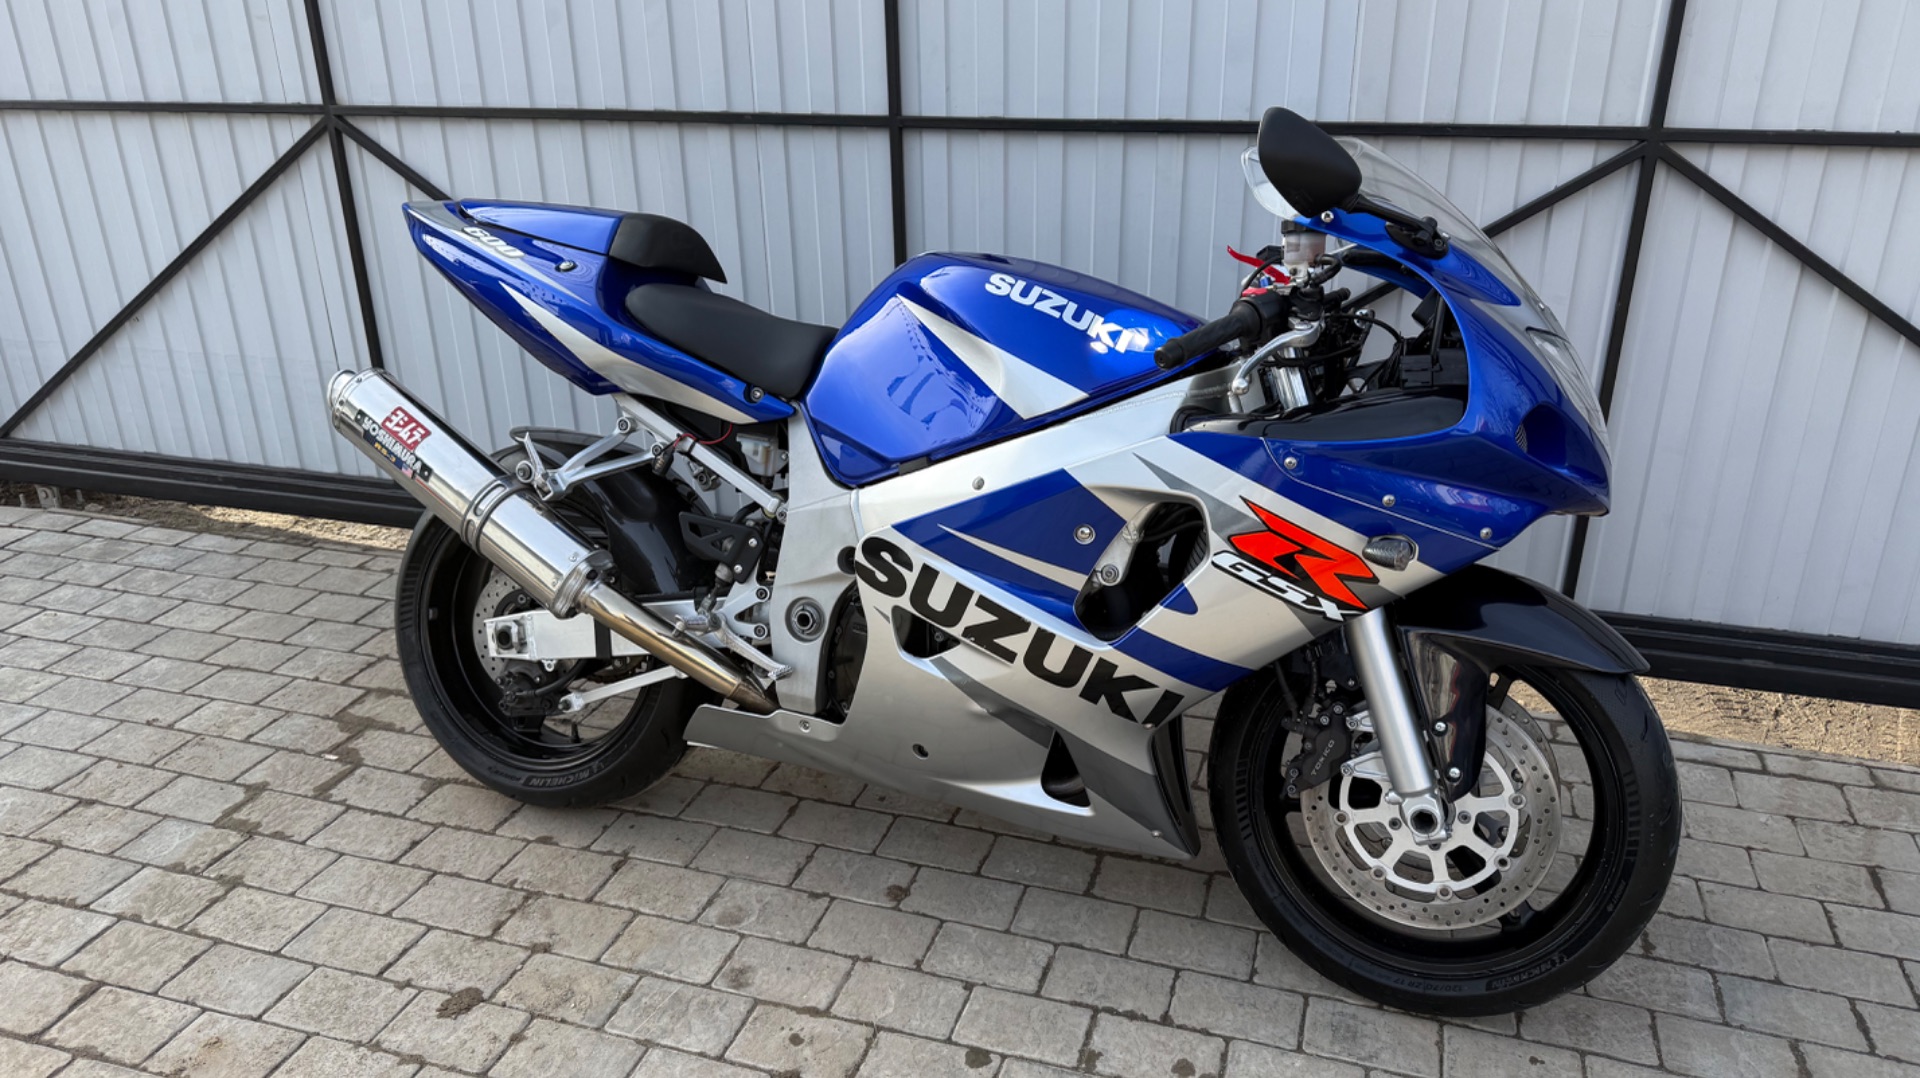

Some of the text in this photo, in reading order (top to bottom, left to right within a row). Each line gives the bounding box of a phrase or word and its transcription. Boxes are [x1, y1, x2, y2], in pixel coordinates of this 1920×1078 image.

[462, 226, 524, 259] 600
[985, 273, 1134, 354] SUZUKI
[362, 416, 422, 474] YOSHIMURA
[384, 410, 426, 444] ヨシムラ
[855, 536, 1185, 728] SUZUKI
[1310, 739, 1335, 776] TOKICO
[528, 768, 590, 787] MICHELIN
